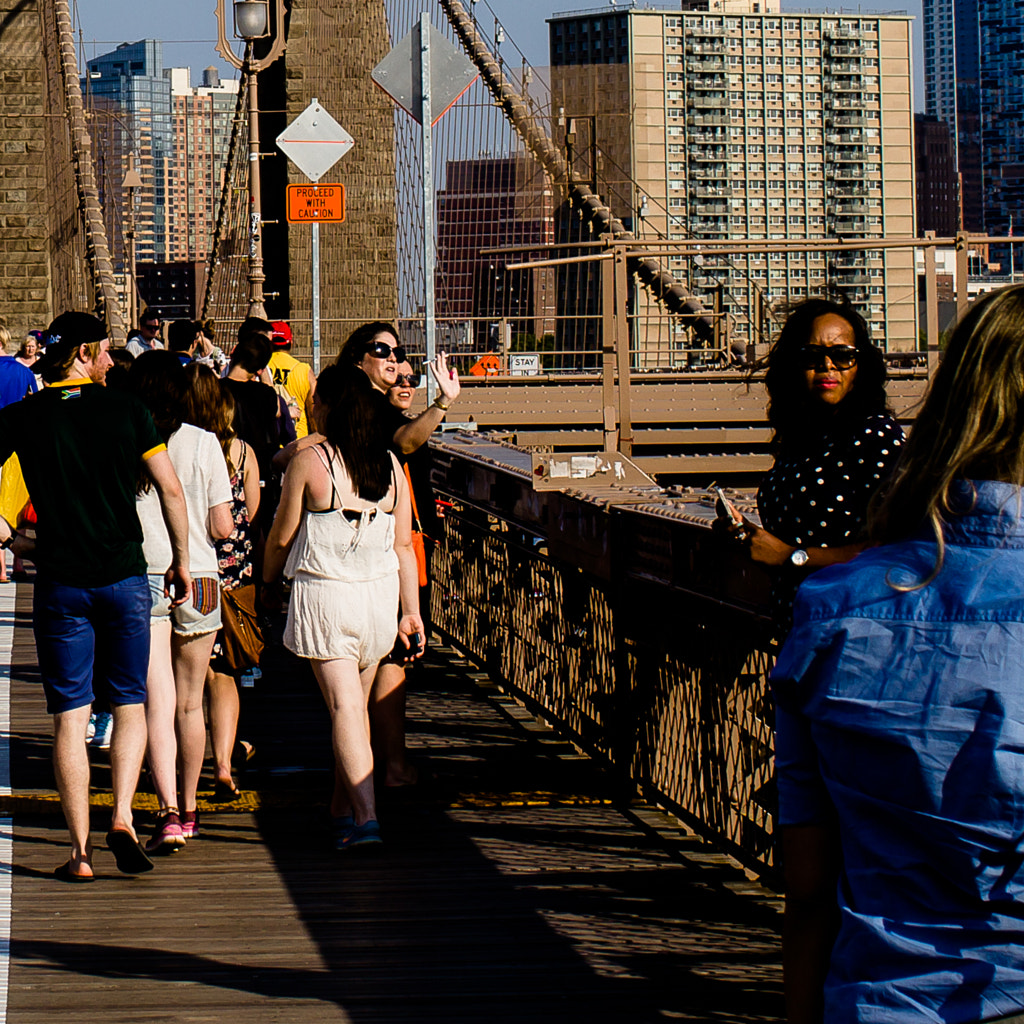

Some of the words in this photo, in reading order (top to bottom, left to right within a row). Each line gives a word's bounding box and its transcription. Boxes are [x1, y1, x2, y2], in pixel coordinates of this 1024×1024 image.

[297, 188, 334, 197] PROCEED
[306, 199, 325, 207] WITH
[515, 358, 534, 366] STAY
